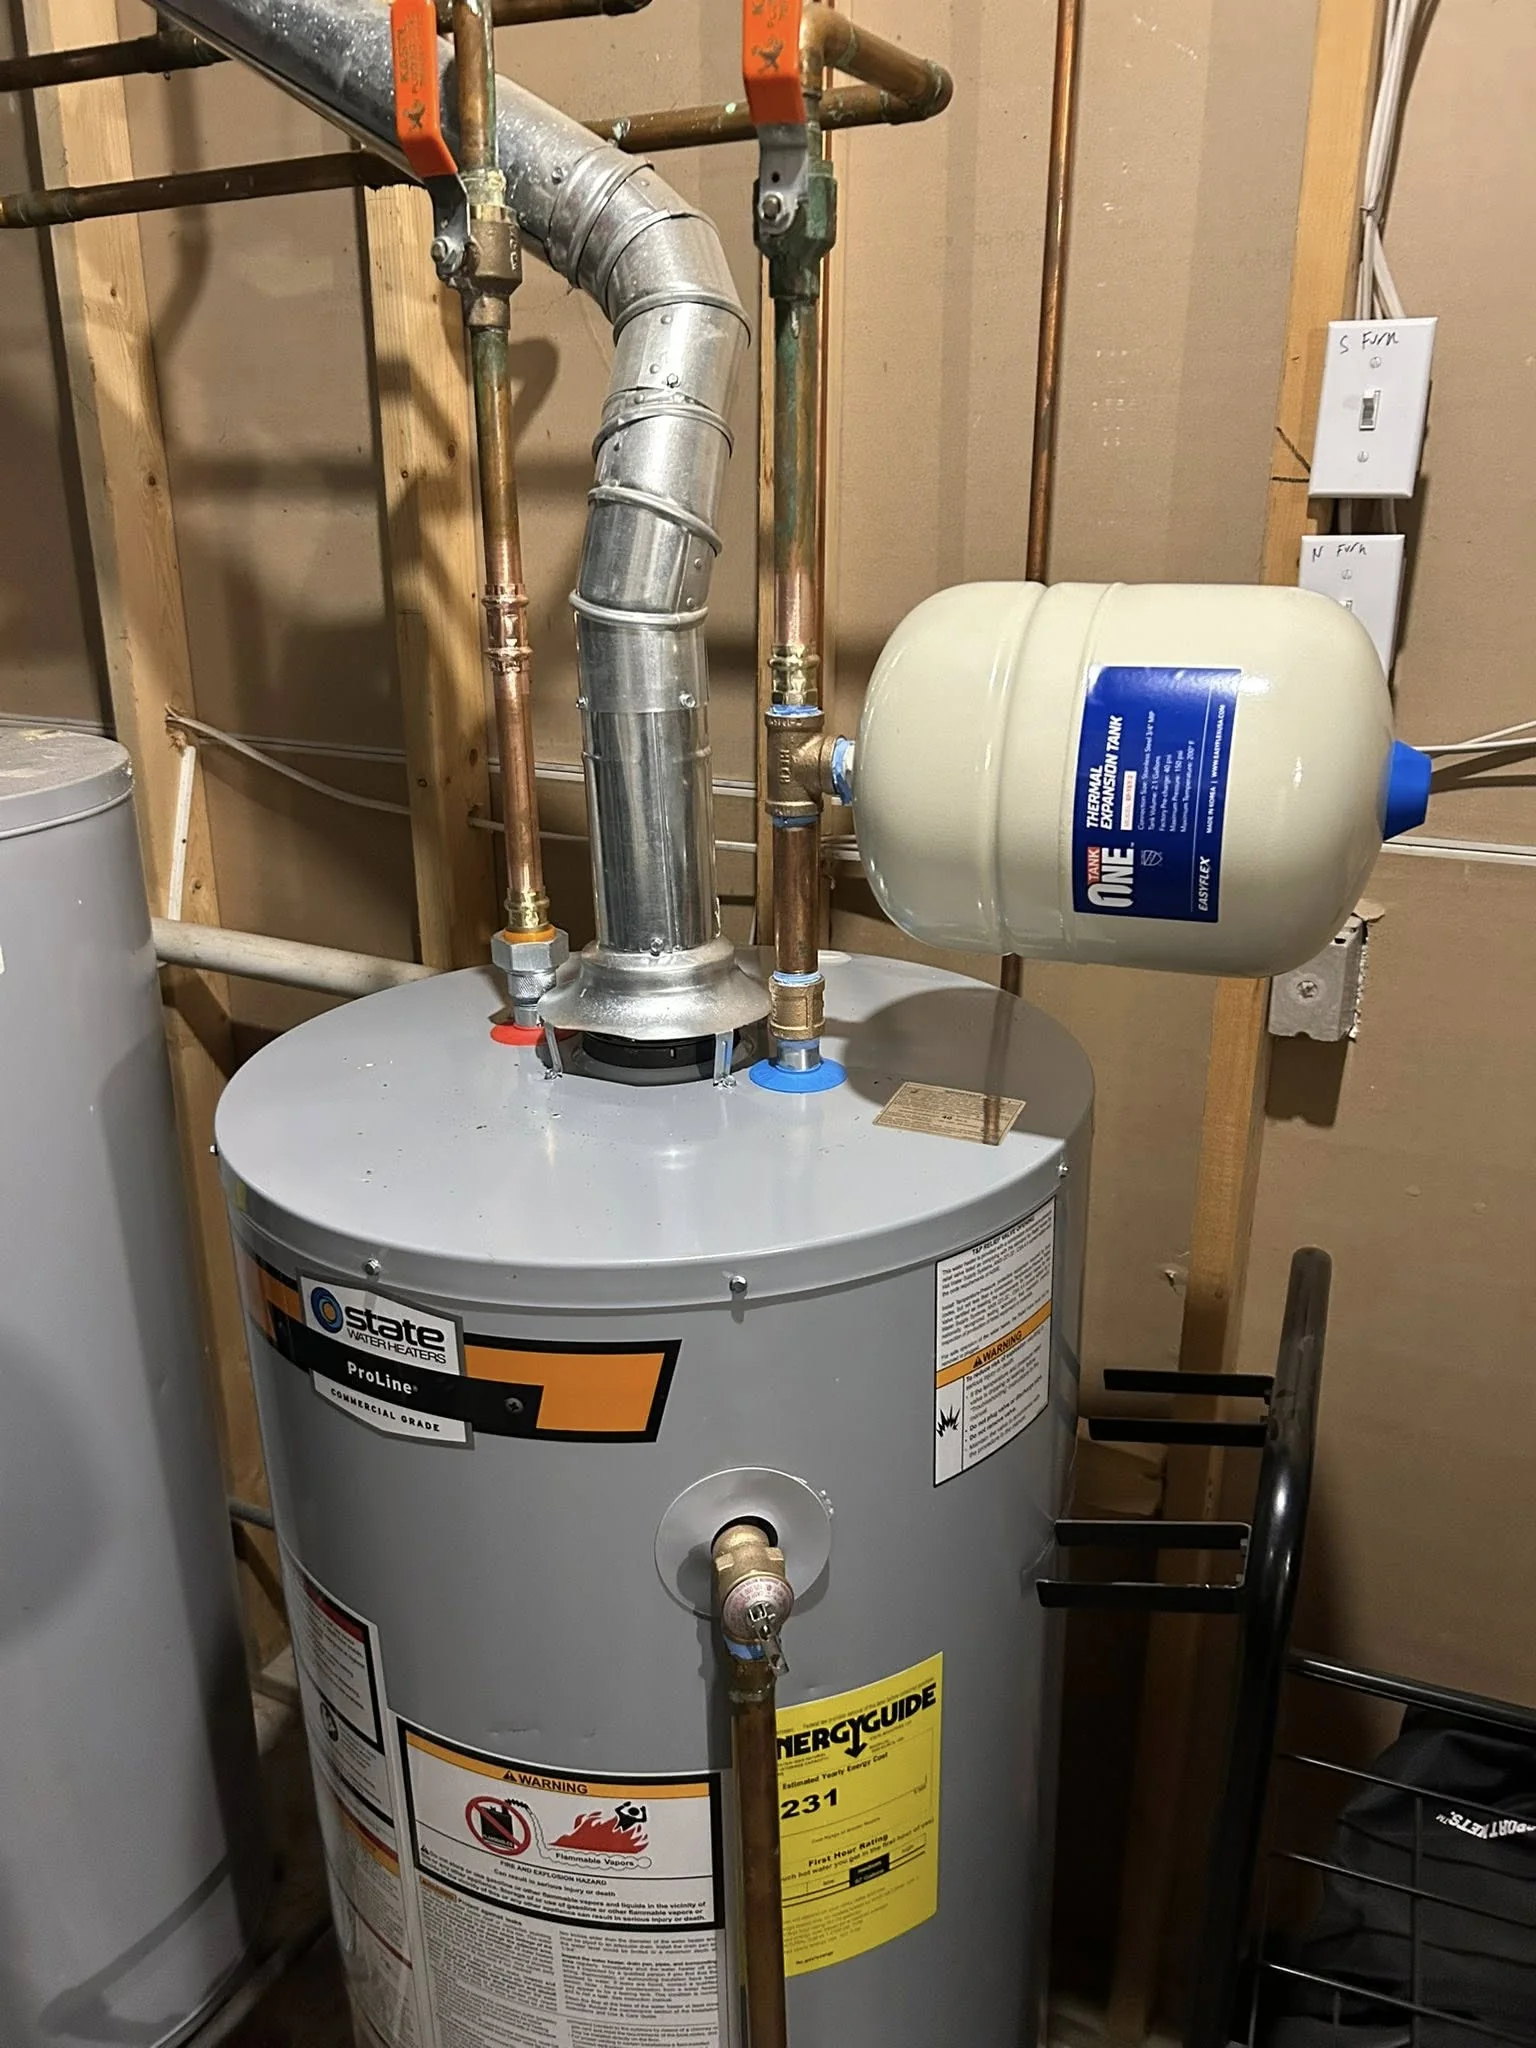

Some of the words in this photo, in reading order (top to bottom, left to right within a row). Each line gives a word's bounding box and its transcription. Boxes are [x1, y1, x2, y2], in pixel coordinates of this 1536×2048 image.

[1312, 546, 1324, 562] N
[1106, 715, 1123, 752] TANK
[1086, 765, 1103, 828] THERMAL
[1100, 753, 1118, 830] EXPANSION
[1206, 816, 1214, 834] MADE
[1208, 808, 1214, 816] IN
[1088, 848, 1100, 884] TANK
[1198, 856, 1210, 912] EASYFLEX
[344, 1306, 445, 1352] state
[347, 1328, 387, 1350] WATER
[388, 1342, 446, 1364] HEATERS
[982, 1331, 1023, 1362] WARNING
[331, 1388, 396, 1420] COMMERCIAL
[401, 1415, 440, 1432] GRADE
[776, 1682, 937, 1760] NERGYGUIDE
[518, 1773, 588, 1794] WARNING
[782, 1775, 820, 1790] Estimated
[822, 1768, 844, 1780] Yearly
[847, 1760, 872, 1772] Energy
[873, 1752, 888, 1763] Cost
[556, 1852, 601, 1864] Flammable
[604, 1858, 634, 1867] Vapors
[808, 1854, 832, 1867] First
[834, 1847, 857, 1859] Hour
[859, 1834, 889, 1850] Rating
[494, 1868, 507, 1876] Can
[508, 1873, 528, 1882] result
[537, 1880, 562, 1890] serious
[564, 1886, 584, 1894] injury
[500, 1860, 516, 1870] FIRE
[517, 1865, 532, 1874] AND
[534, 1869, 574, 1882] EXPLOSION
[576, 1876, 607, 1886] HAZARD
[798, 1870, 811, 1878] hot
[812, 1863, 832, 1874] water
[580, 1899, 604, 1907] vapors
